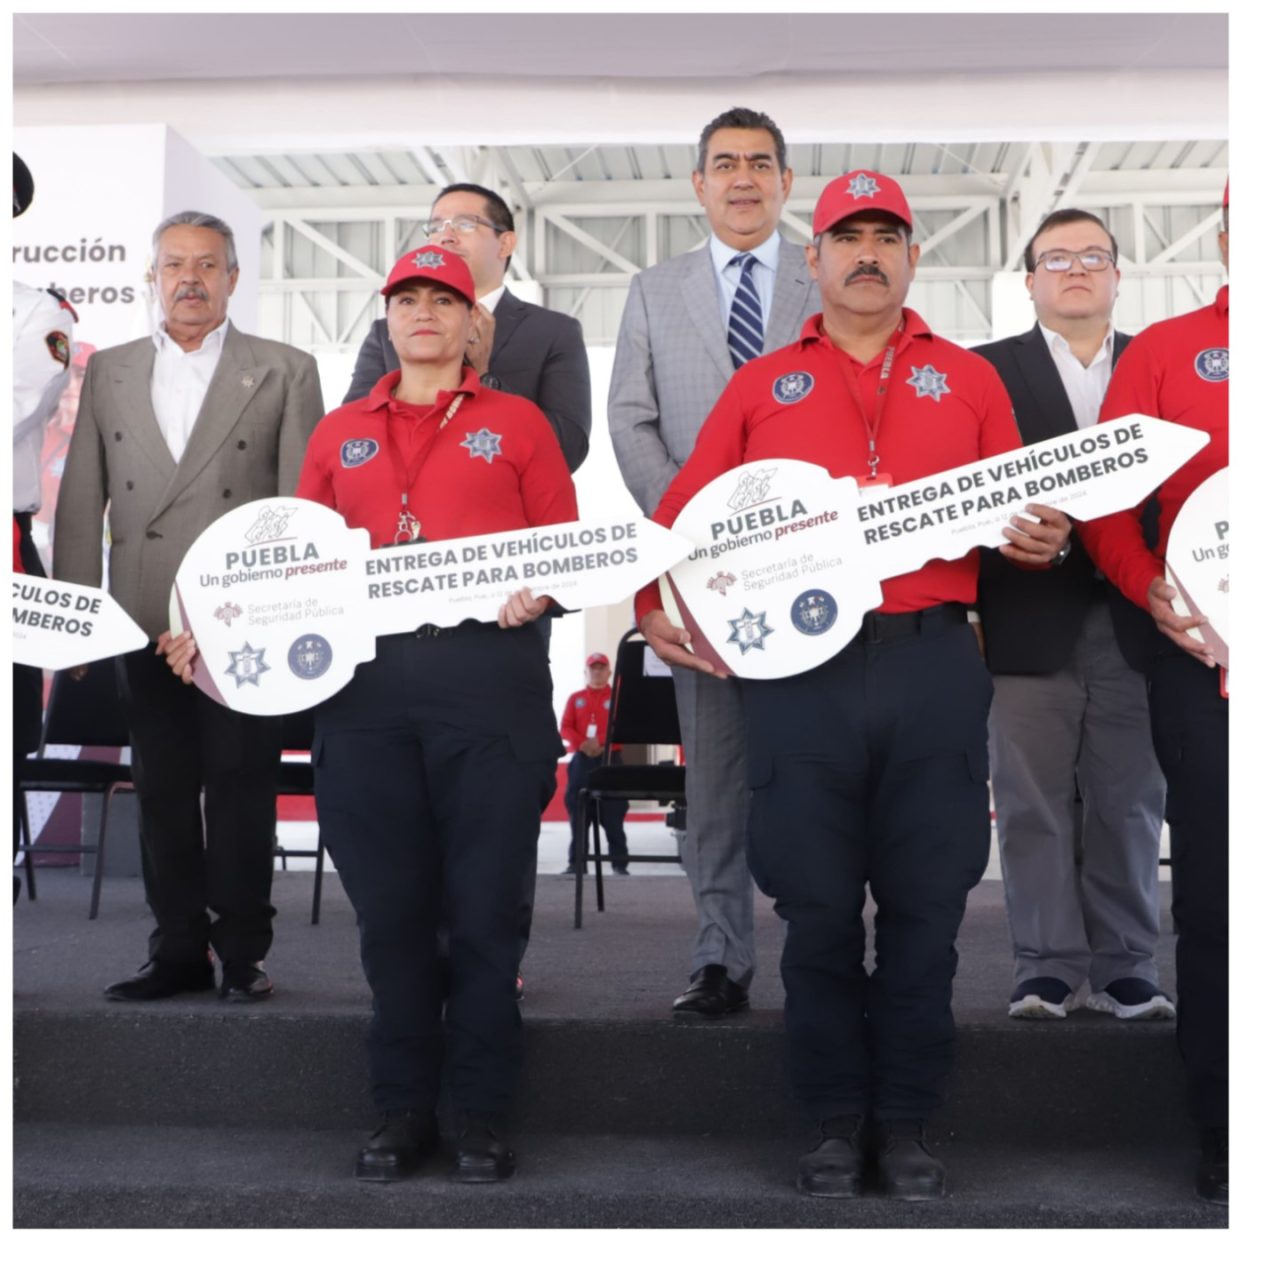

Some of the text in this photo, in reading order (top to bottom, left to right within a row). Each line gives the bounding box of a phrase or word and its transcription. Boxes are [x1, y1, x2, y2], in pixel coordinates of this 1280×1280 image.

[857, 422, 1144, 522] ENTREGA DE VEHÍCULOS DE
[863, 447, 1149, 545] RESCATE PARA BOMBEROS
[710, 529, 773, 559] gobierno
[775, 509, 839, 541] presente
[711, 498, 808, 541] PUEBLA
[225, 542, 320, 570] PUEBLA
[365, 523, 637, 576] ENTREGA DE VEHÍCULOS DE
[1192, 547, 1216, 562] Un
[199, 558, 348, 588] Un gobierno presente
[368, 548, 638, 599] RESCATE PARA BOMBEROS
[741, 552, 815, 581] Secretaría de
[743, 556, 843, 592] Seguridad Pública
[75, 595, 102, 614] DE
[247, 597, 319, 615] Secretaría de
[248, 606, 345, 626] Seguridad Pública
